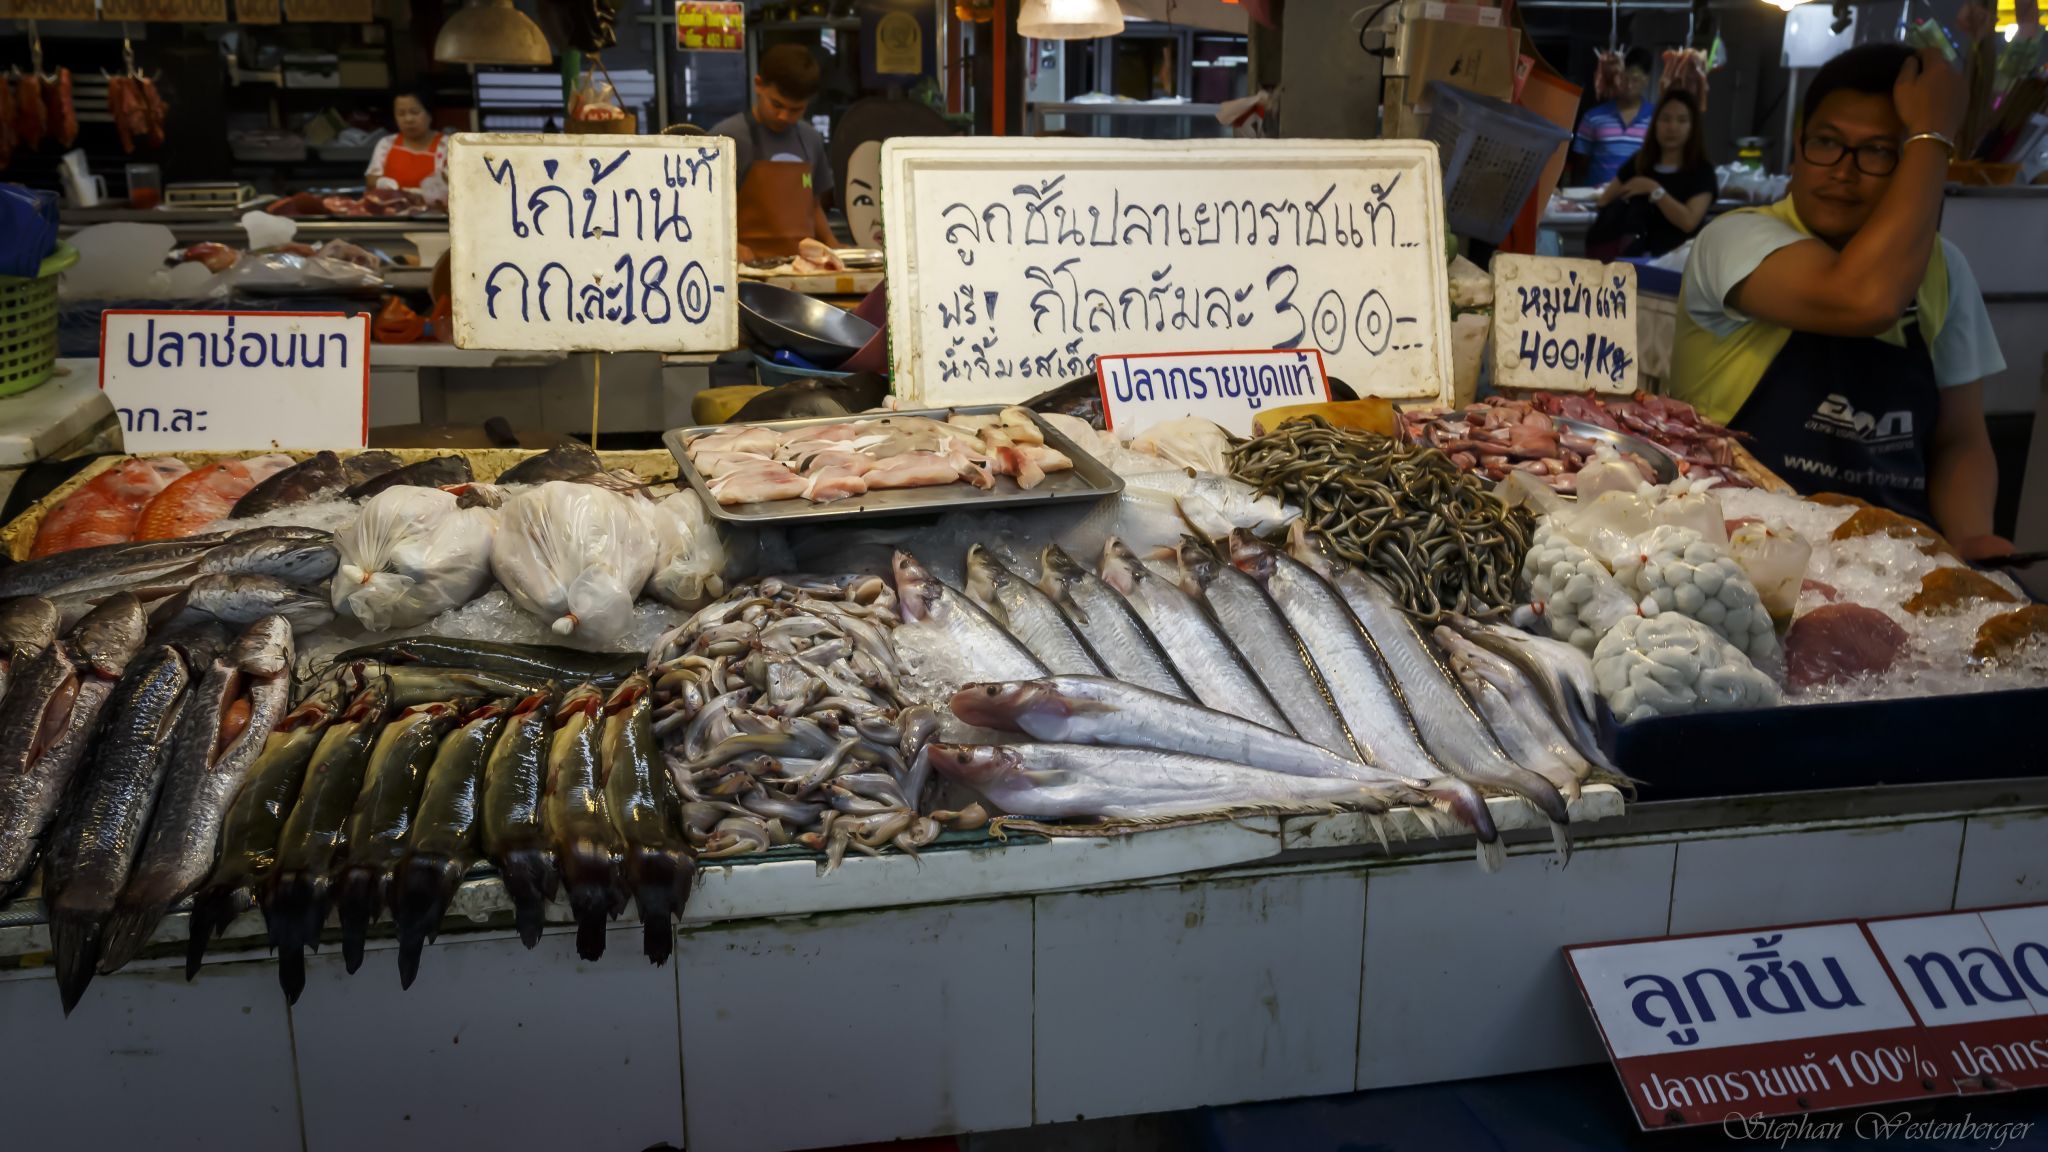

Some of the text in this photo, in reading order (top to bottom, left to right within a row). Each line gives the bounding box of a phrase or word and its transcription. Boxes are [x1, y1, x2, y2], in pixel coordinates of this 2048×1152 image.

[483, 146, 720, 242] ไก่บ้าน แท้
[127, 315, 348, 368] ปลาช่อนนา
[1112, 351, 1316, 409] ปลากรายขูดแท้
[1623, 933, 1865, 1047] ลูกชิ้น
[1640, 1038, 2048, 1112] ปลากรายแท้ 100% ปลากร
